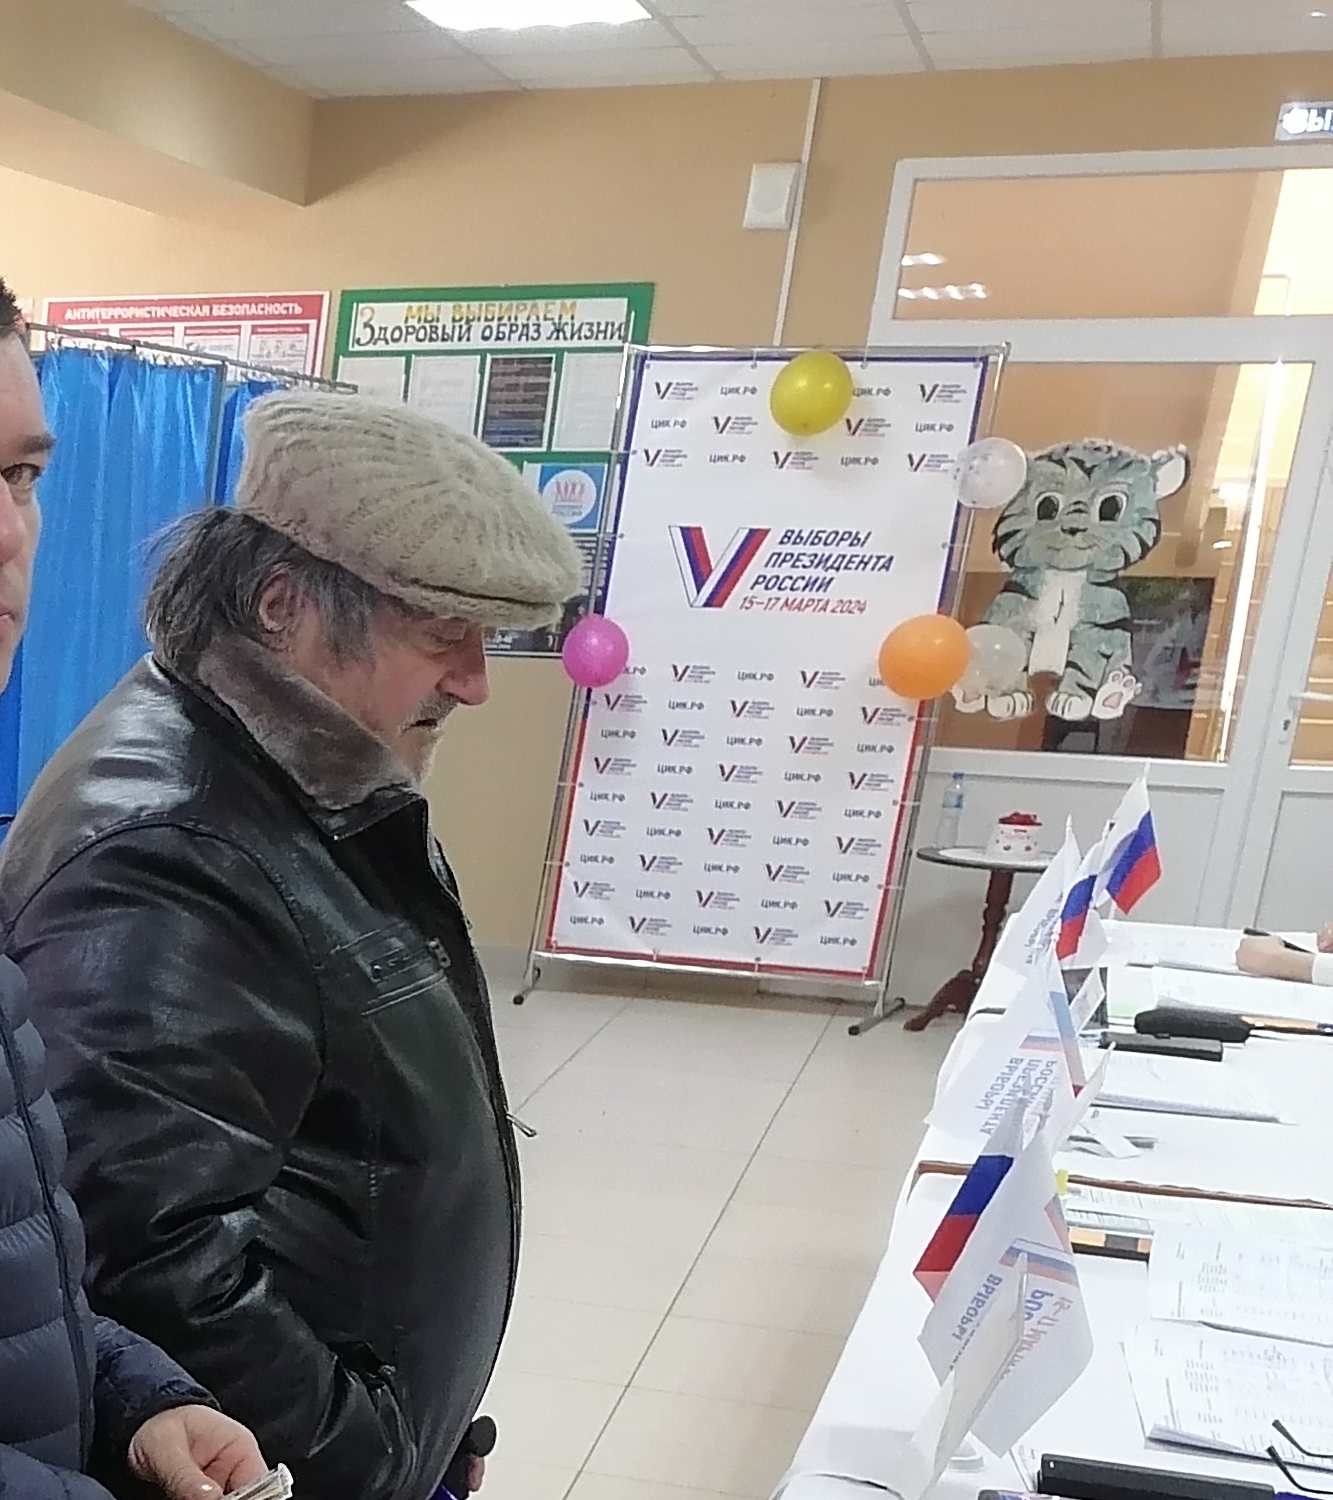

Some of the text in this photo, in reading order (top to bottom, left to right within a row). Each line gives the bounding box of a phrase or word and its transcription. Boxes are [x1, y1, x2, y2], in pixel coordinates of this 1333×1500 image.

[64, 303, 303, 321] АНТИТЕРРОРИСТИЧЕСКАЯ БЕЗОПАСНОСТЬ
[404, 301, 578, 324] МЫ ВЫБИРАЕМ
[480, 322, 542, 342] ОБРАЗ
[546, 320, 625, 341] ЖИЗНИ
[778, 528, 871, 548] ВЫБОРЫ
[764, 552, 895, 574] ПРЕЗИДЕНТА
[750, 575, 836, 593] РОССИИ
[782, 598, 831, 614] МАРТА
[831, 599, 868, 615] 2024
